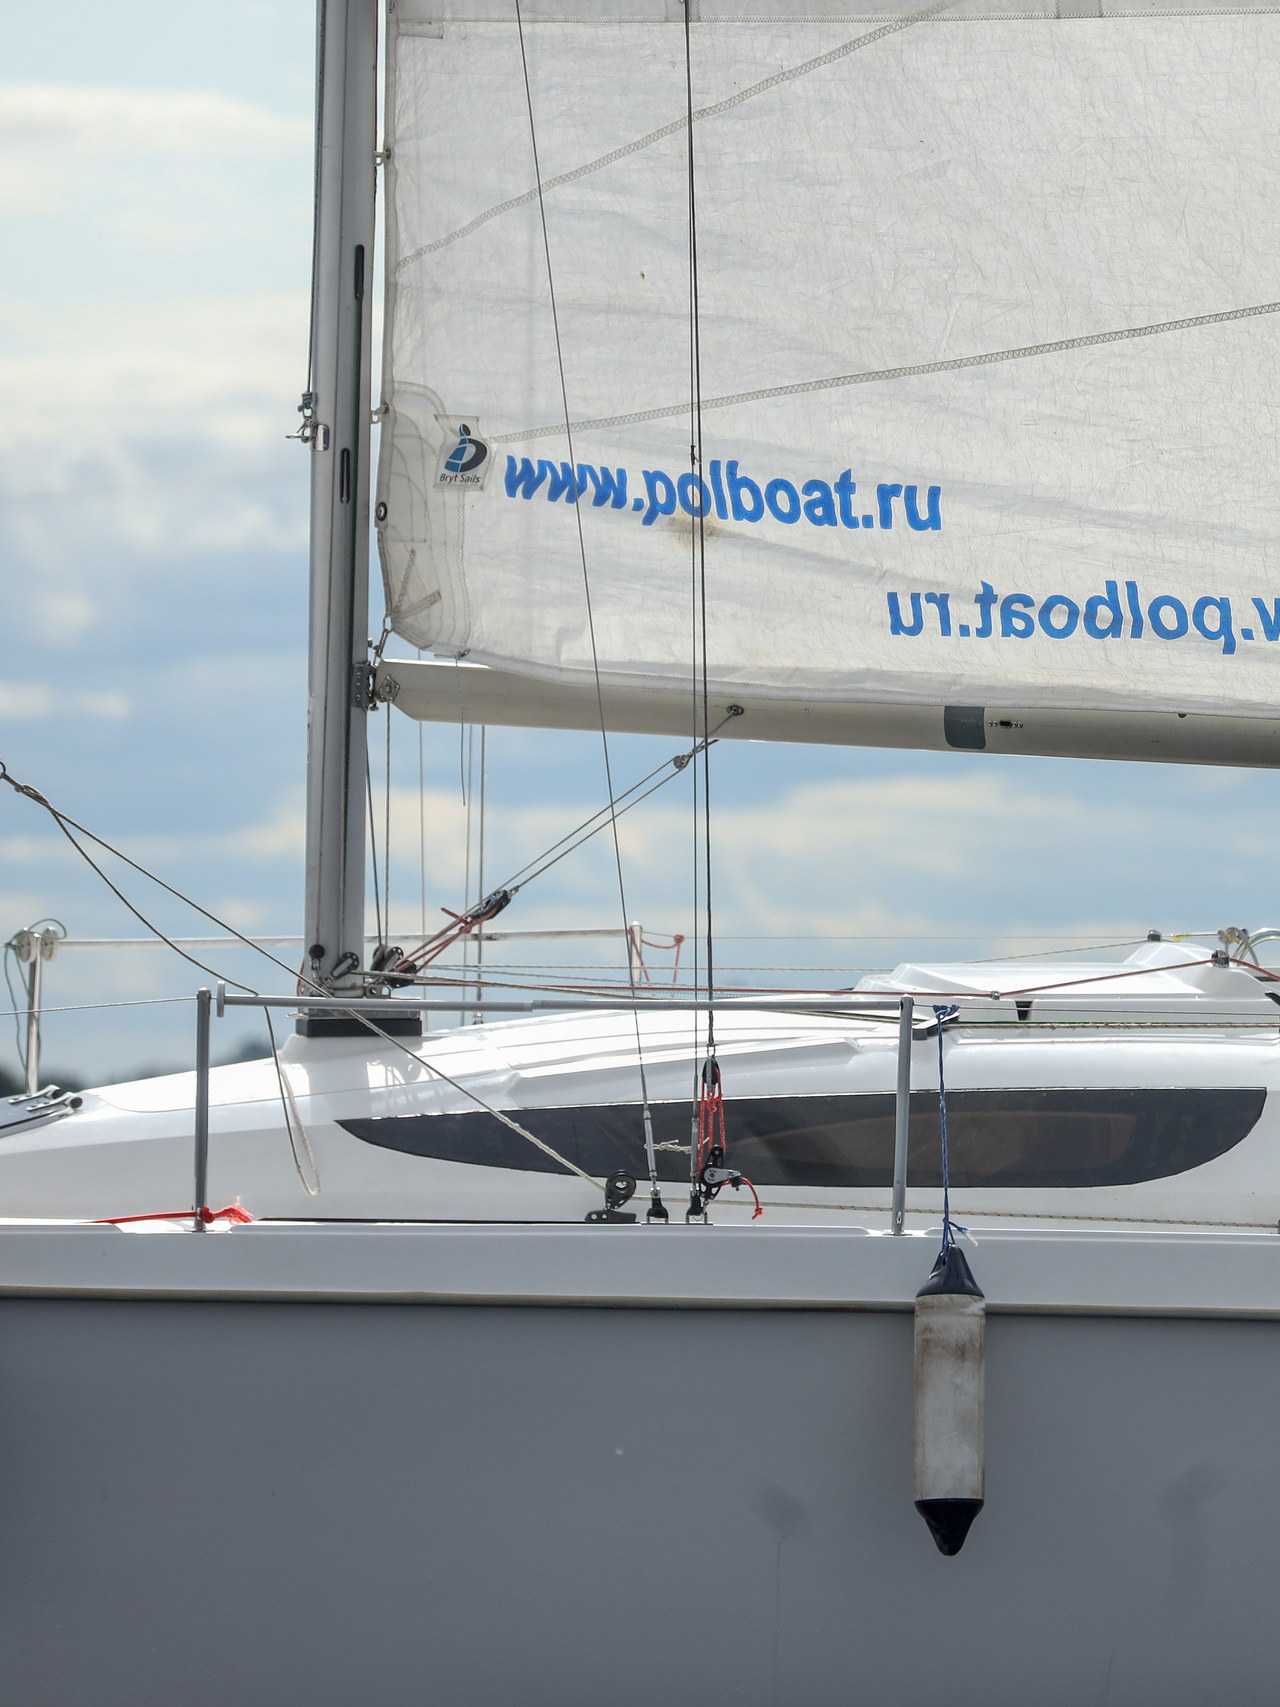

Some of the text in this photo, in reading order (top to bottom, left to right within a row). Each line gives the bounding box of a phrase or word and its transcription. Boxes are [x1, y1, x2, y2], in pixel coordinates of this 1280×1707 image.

[439, 473, 481, 484] Bryt Sails
[505, 455, 942, 531] www.polboat.ru
